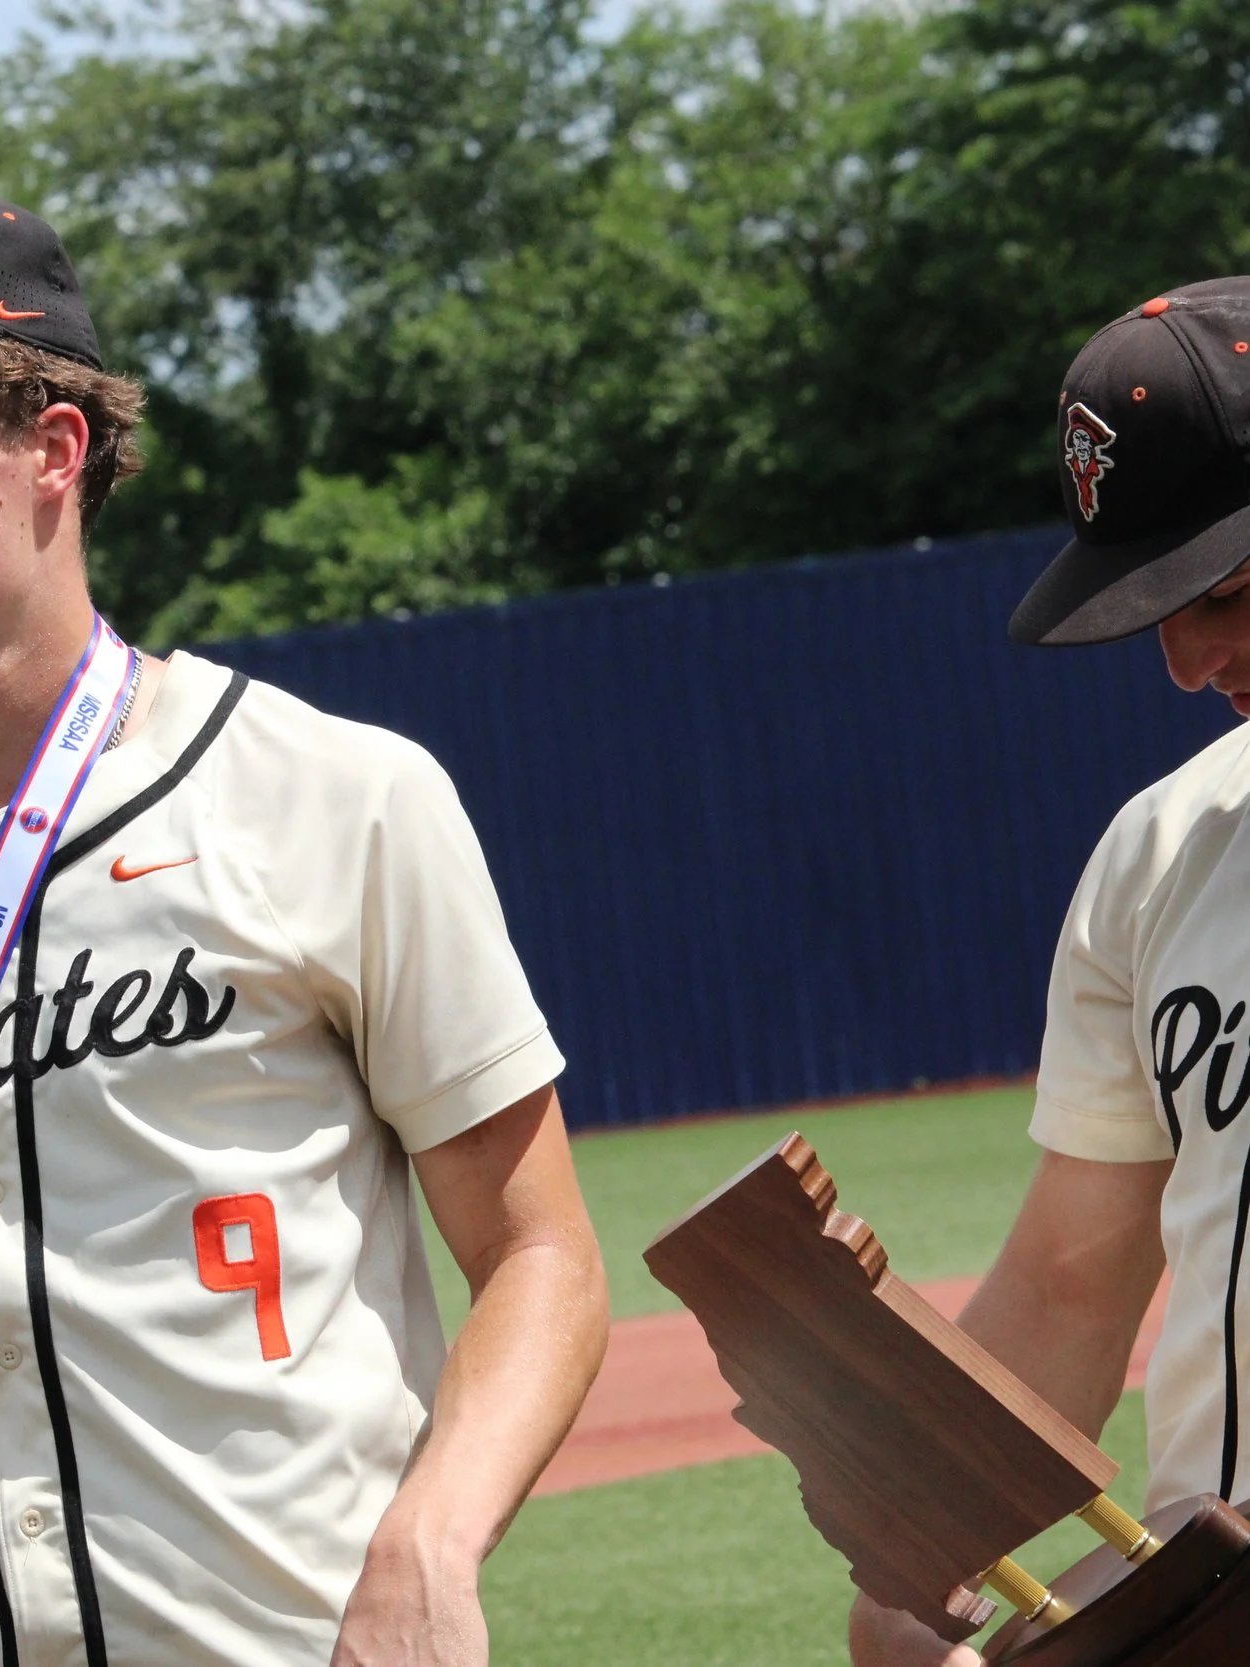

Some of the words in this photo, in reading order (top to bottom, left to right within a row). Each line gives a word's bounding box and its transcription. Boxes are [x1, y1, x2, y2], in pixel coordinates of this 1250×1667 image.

[58, 692, 103, 752] MSHSAA
[1151, 985, 1250, 1158] Pi
[192, 1190, 292, 1362] 9
